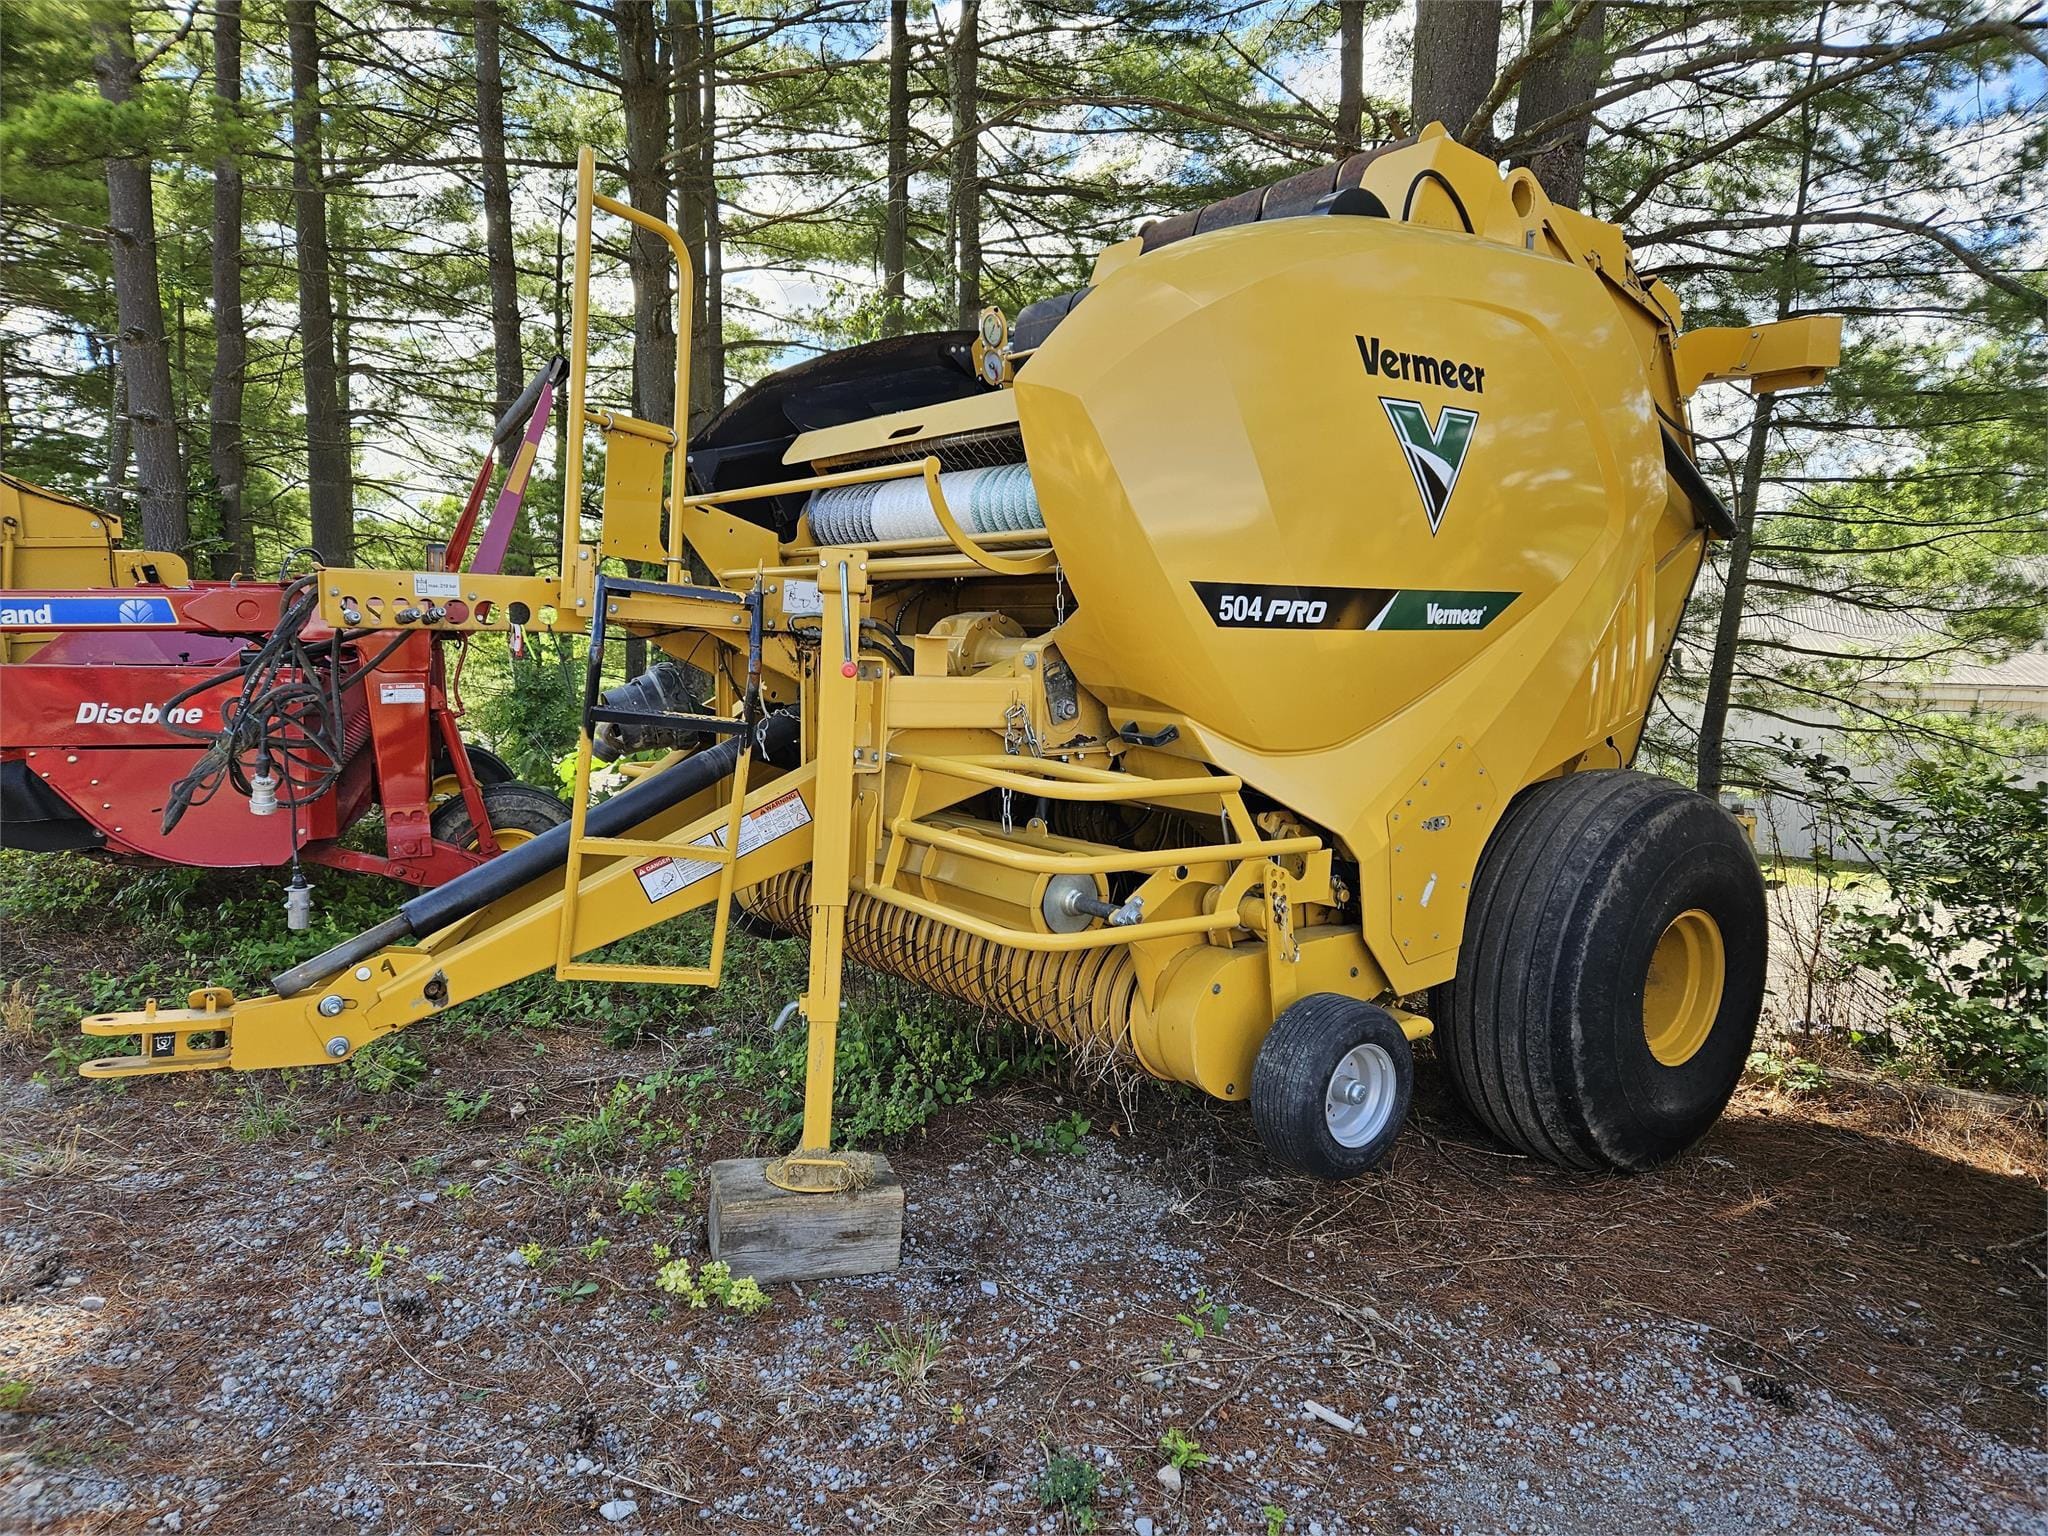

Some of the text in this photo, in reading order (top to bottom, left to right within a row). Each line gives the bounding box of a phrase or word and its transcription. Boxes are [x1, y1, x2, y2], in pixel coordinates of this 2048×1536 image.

[1355, 335, 1485, 393] Vermeer
[0, 604, 50, 624] and
[1219, 595, 1328, 623] 504 PRO
[1427, 603, 1485, 625] Vermeer
[76, 702, 203, 724] Discbne
[764, 793, 796, 811] WARNING
[645, 857, 671, 872] DANGER
